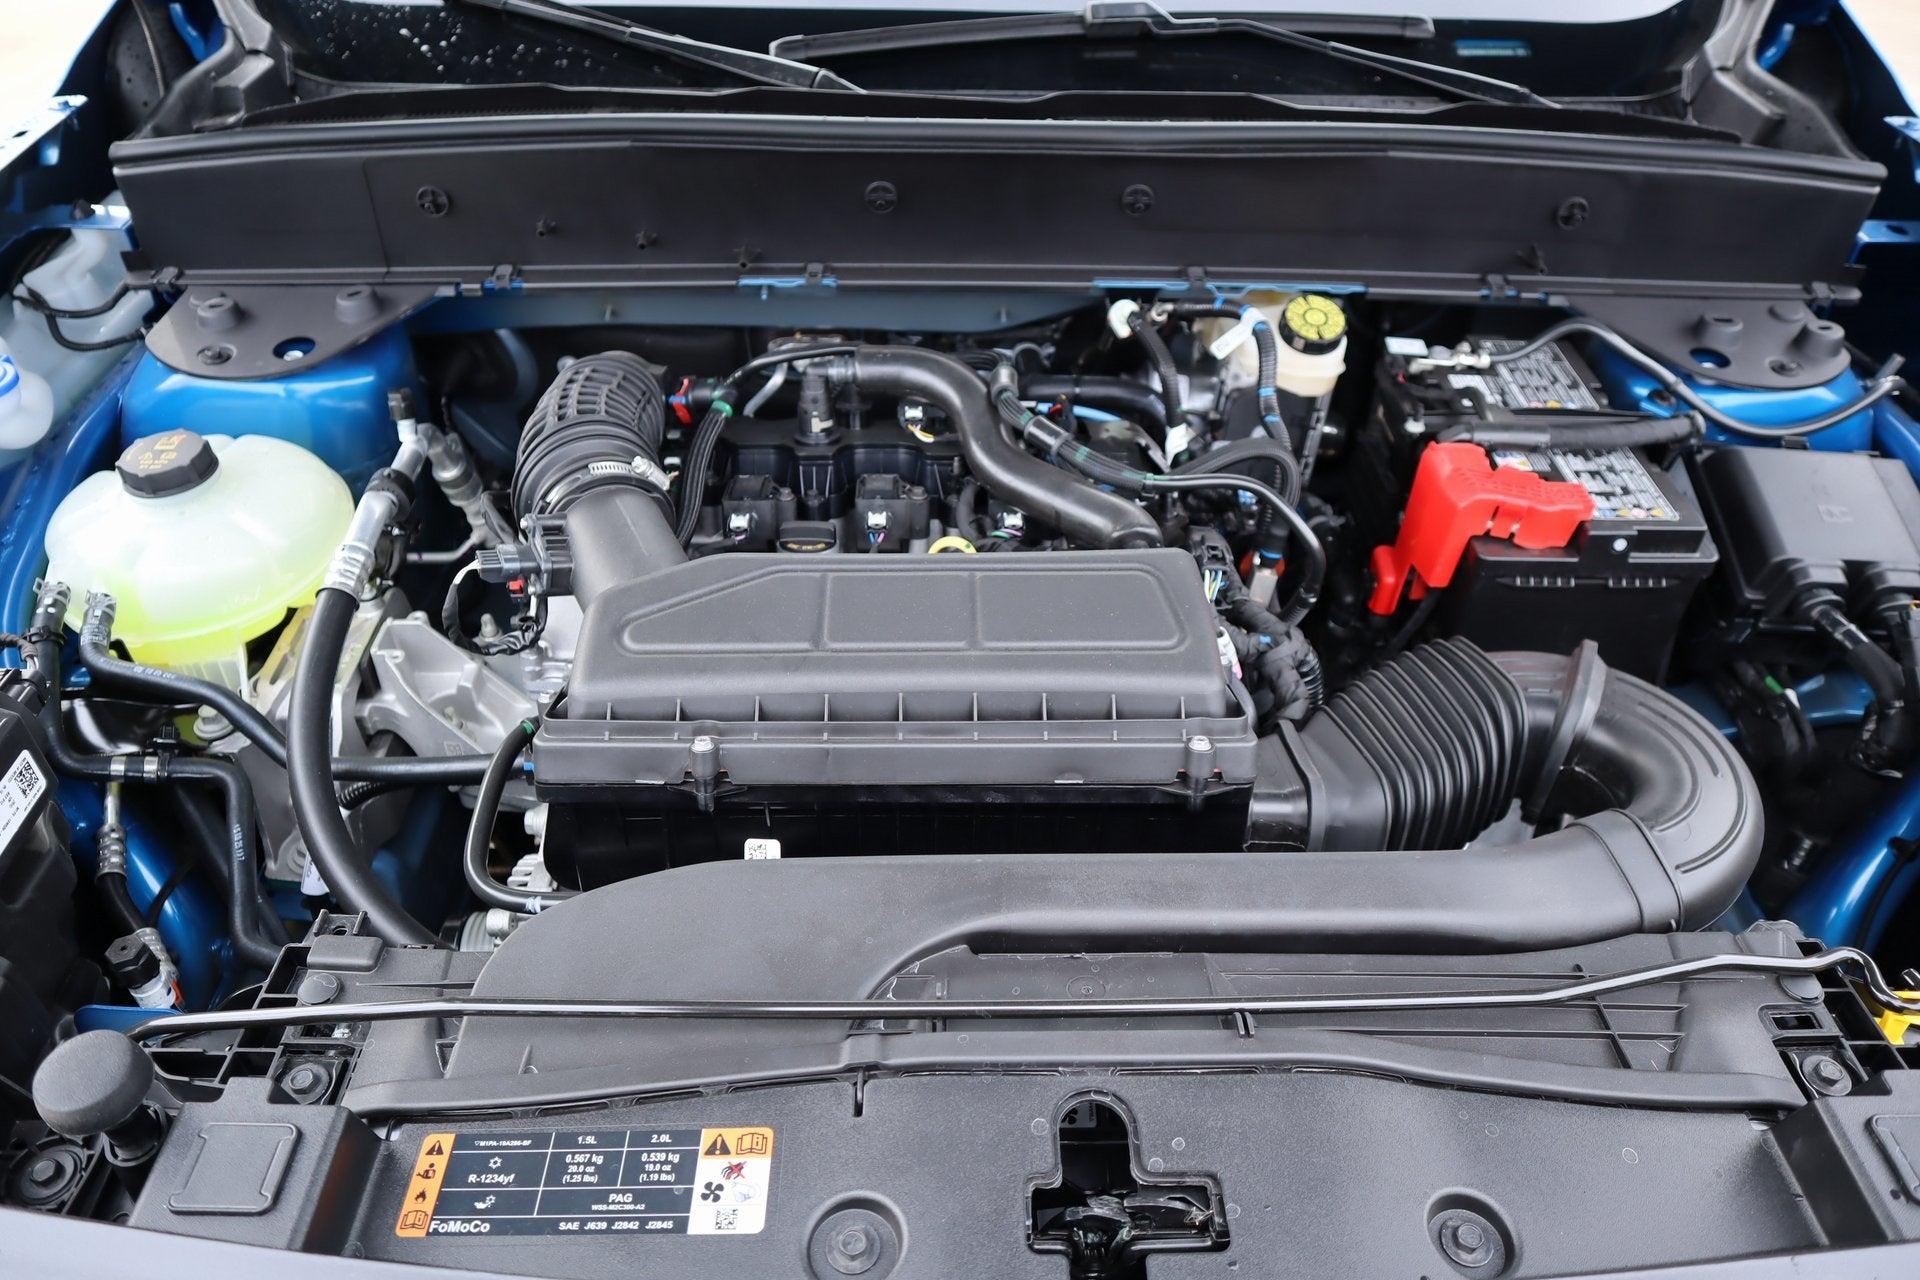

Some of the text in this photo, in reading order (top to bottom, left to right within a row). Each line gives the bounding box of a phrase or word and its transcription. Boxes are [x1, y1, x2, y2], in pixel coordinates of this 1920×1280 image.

[577, 1135, 598, 1145] 1.5L
[650, 1133, 673, 1143] 2.0L
[565, 1153, 604, 1165] 0.567 kg
[641, 1152, 680, 1164] 0.539 kg
[567, 1165, 584, 1173] 20.0
[644, 1163, 672, 1172] 19.0 oz
[467, 1173, 516, 1185] R-1234yf
[562, 1174, 598, 1183] (1.25 lbs)
[639, 1172, 675, 1183] (1.19 lbs)
[608, 1193, 633, 1203] PAG
[428, 1220, 491, 1233] FoMoCo
[558, 1220, 674, 1230] SAE J639 J2842 J2845
